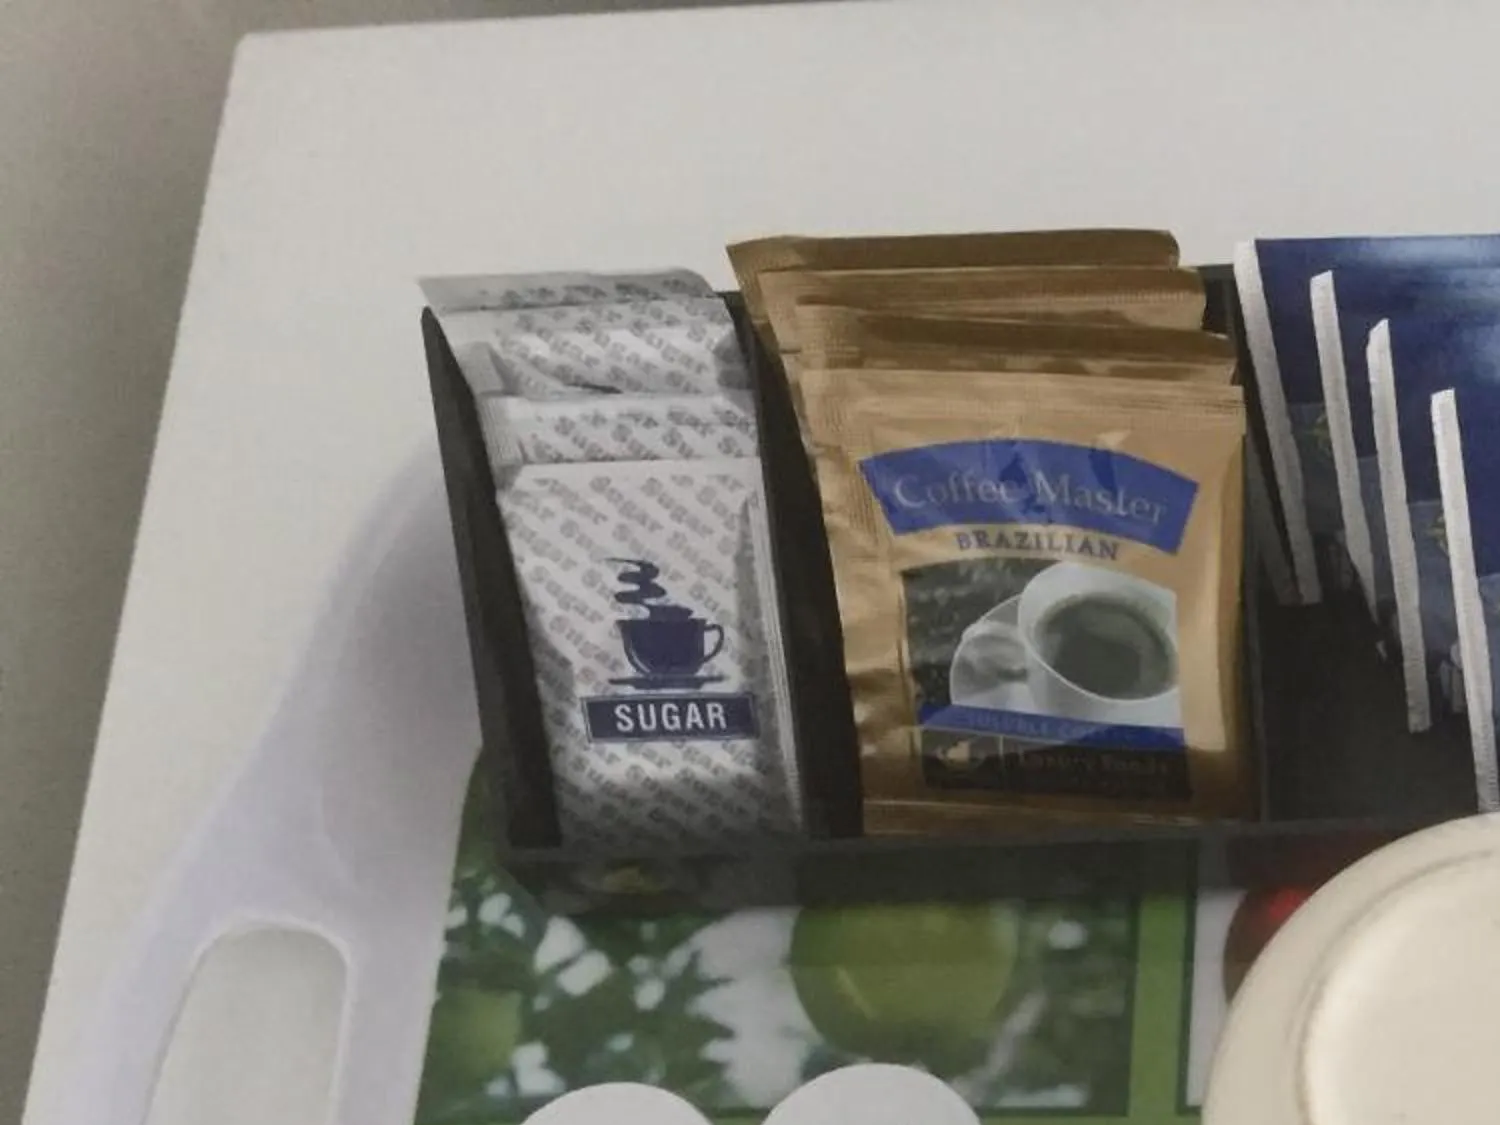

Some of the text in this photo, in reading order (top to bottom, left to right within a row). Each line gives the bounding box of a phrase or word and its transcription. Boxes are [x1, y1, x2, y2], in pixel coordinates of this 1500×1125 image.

[893, 468, 1172, 526] Coffee Master
[955, 529, 1122, 562] BRAZILIAN
[613, 702, 728, 733] SUGAR
